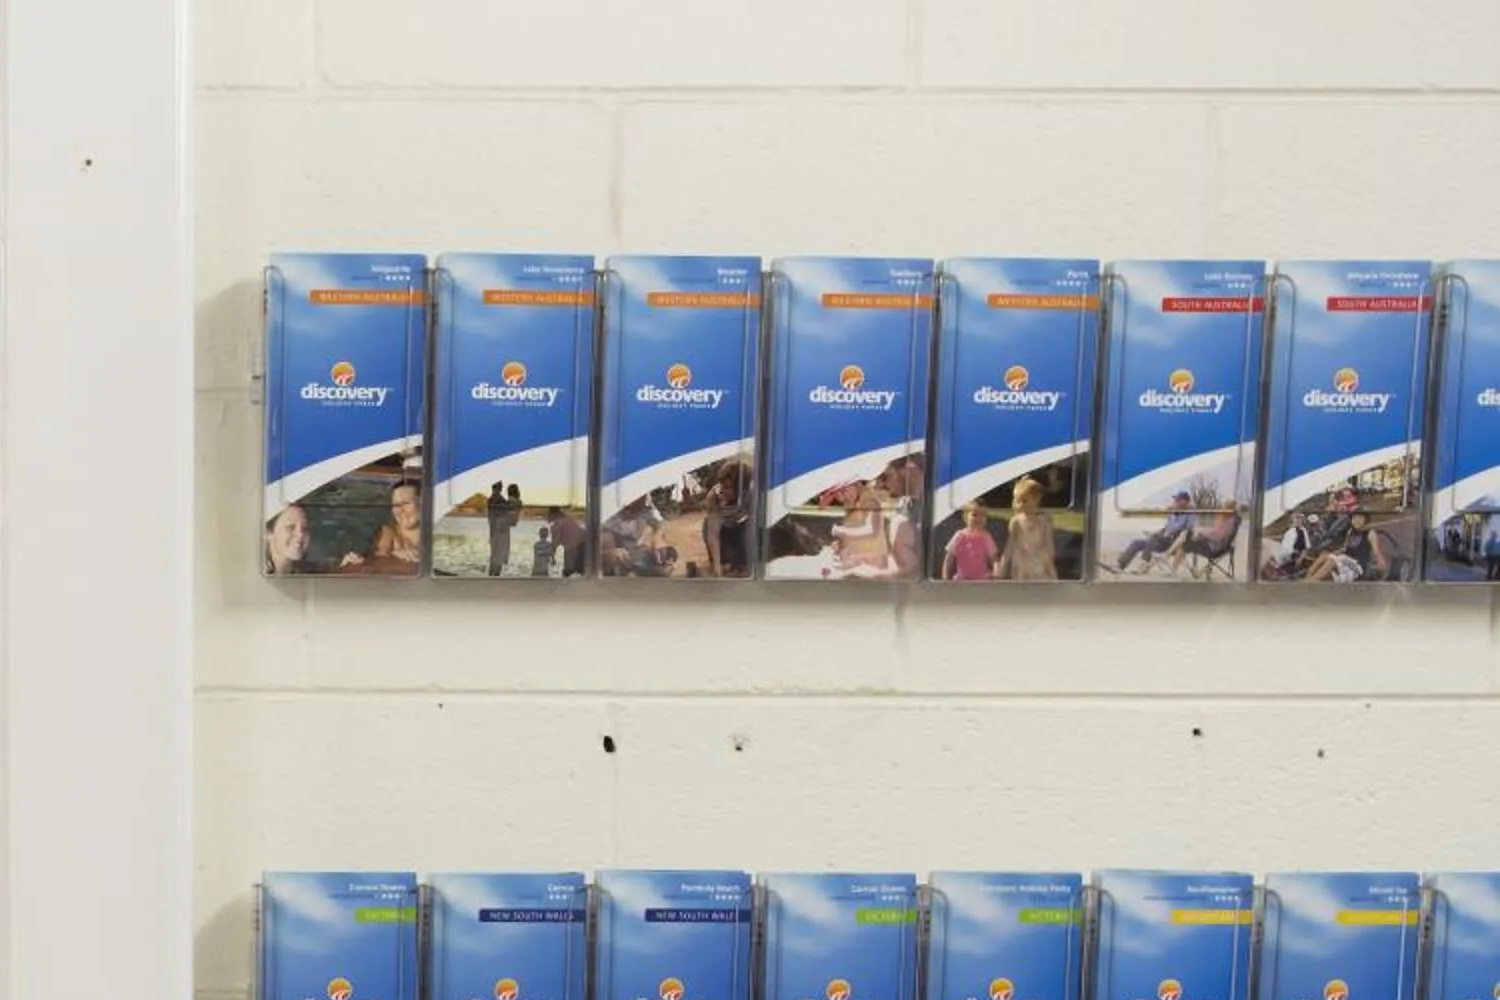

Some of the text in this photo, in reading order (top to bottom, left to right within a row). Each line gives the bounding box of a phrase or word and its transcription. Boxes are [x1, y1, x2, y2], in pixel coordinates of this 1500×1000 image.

[301, 383, 387, 406] discovery
[472, 384, 557, 406] discovery
[636, 386, 722, 408] discovery
[809, 387, 894, 410] discovery
[974, 387, 1059, 411] discovery
[1140, 389, 1224, 413] discovery
[1303, 389, 1389, 413] discovery
